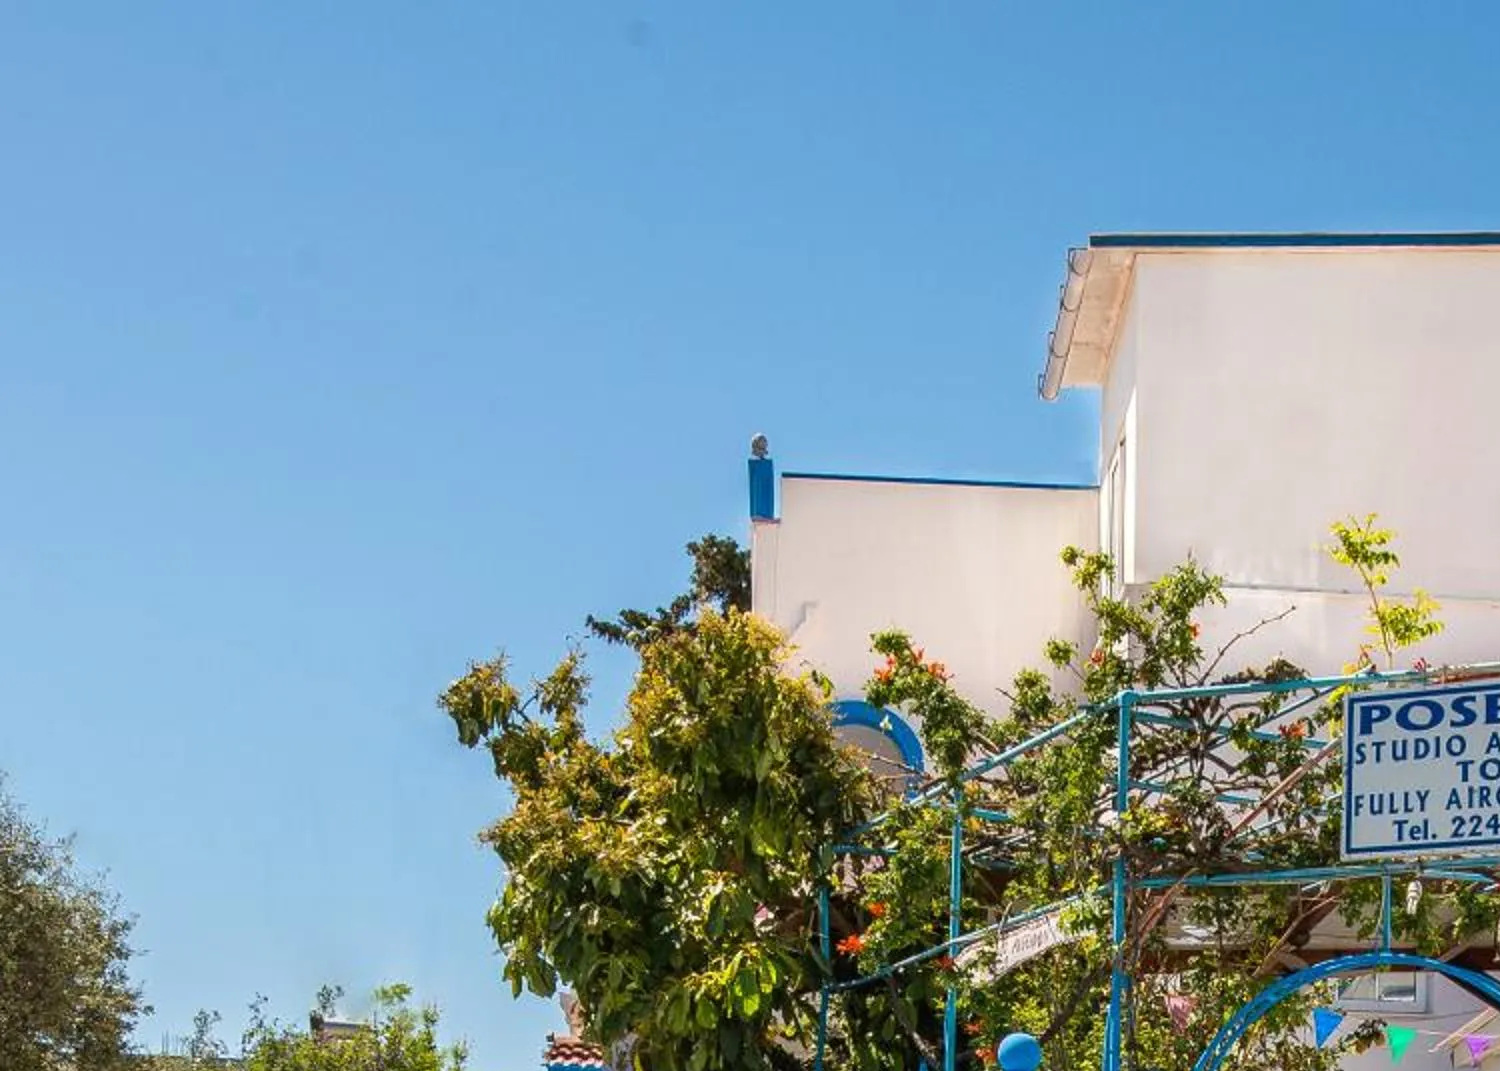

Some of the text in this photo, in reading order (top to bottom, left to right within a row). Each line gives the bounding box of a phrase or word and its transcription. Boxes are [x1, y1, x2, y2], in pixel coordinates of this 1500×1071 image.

[1355, 735, 1467, 765] STUDIO
[1354, 789, 1430, 817] FULLY
[1393, 818, 1438, 843] Tel.
